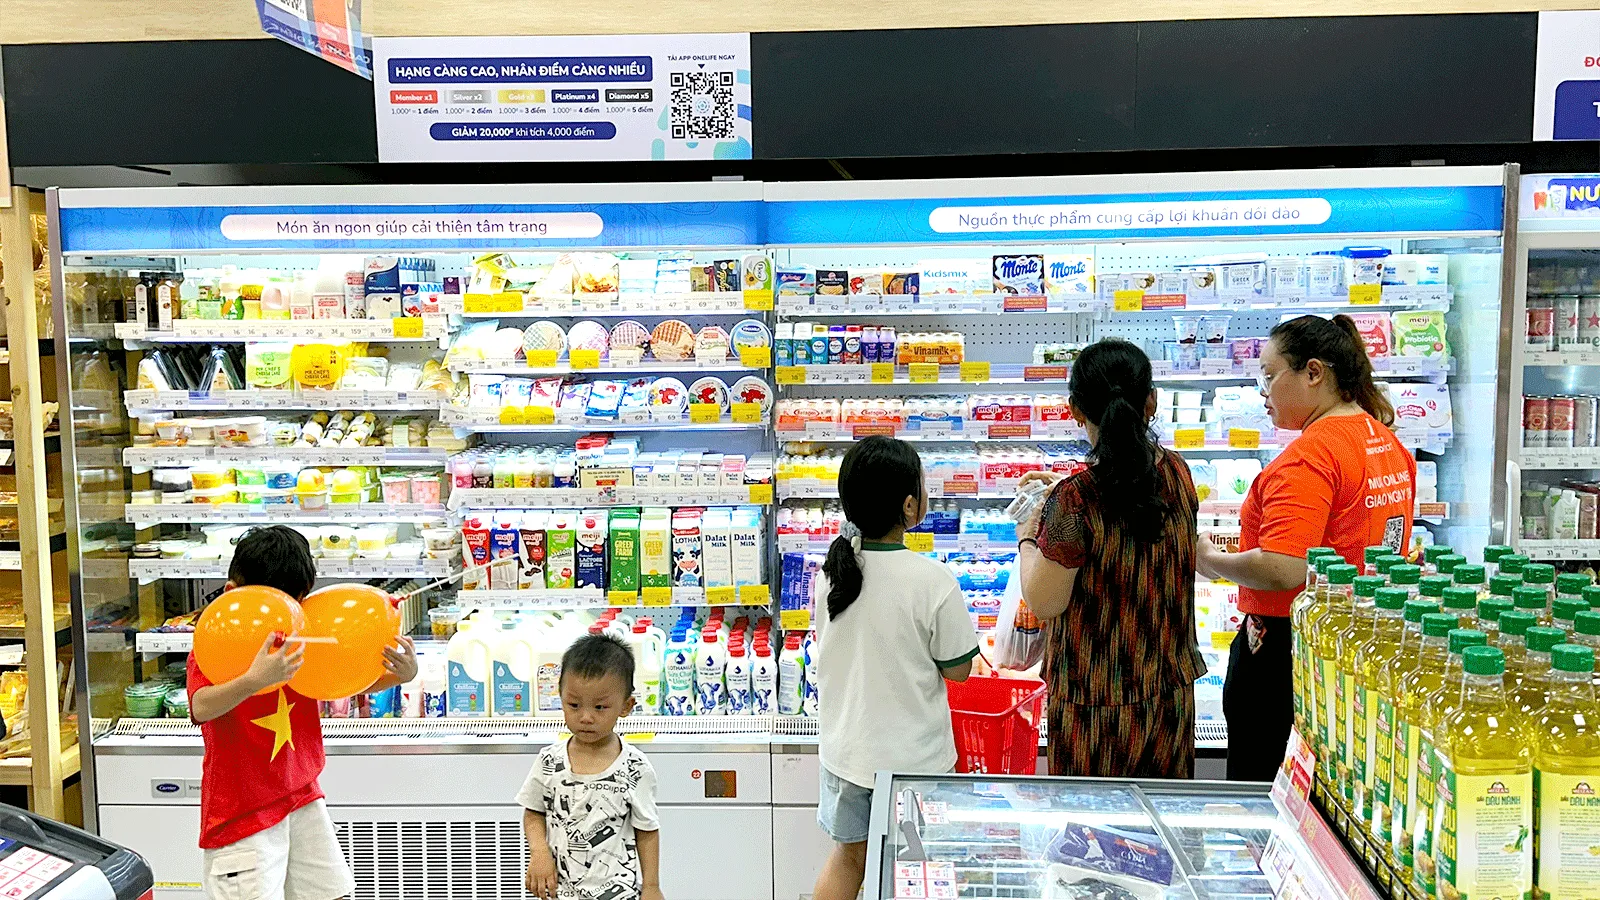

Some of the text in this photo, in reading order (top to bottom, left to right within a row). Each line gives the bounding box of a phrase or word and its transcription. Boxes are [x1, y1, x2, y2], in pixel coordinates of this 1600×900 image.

[395, 60, 646, 80] HẠNG CÀNG CAO, NHÂN ĐIỂM CÀNG NHIỀU
[609, 92, 649, 100] Diamond x5
[452, 125, 477, 137] GIẢM
[515, 128, 528, 137] khi
[530, 126, 545, 137] tích
[547, 127, 572, 137] 4,000
[573, 126, 595, 136] điểm
[959, 212, 1007, 229] Nguồn
[1013, 213, 1044, 229] thực
[1050, 209, 1090, 227] phẩm
[1096, 211, 1132, 226] cung
[1138, 209, 1163, 225] cấp
[1169, 210, 1187, 225] lợi
[277, 219, 547, 236] Món ăn ngon giúp cải thiện tâm trạng
[1001, 259, 1037, 278] Monte
[1050, 261, 1085, 278] Monte
[923, 269, 967, 278] Kidsmix
[1409, 316, 1430, 324] meiji
[914, 346, 949, 356] Vinamilk
[1053, 462, 1076, 471] meiji
[1365, 494, 1387, 508] GIAO
[466, 533, 487, 541] meiji
[495, 533, 515, 541] meiji
[523, 533, 543, 541] meiji
[614, 540, 633, 548] GREEN
[615, 549, 633, 557] FARM
[801, 572, 812, 605] Vinamilk
